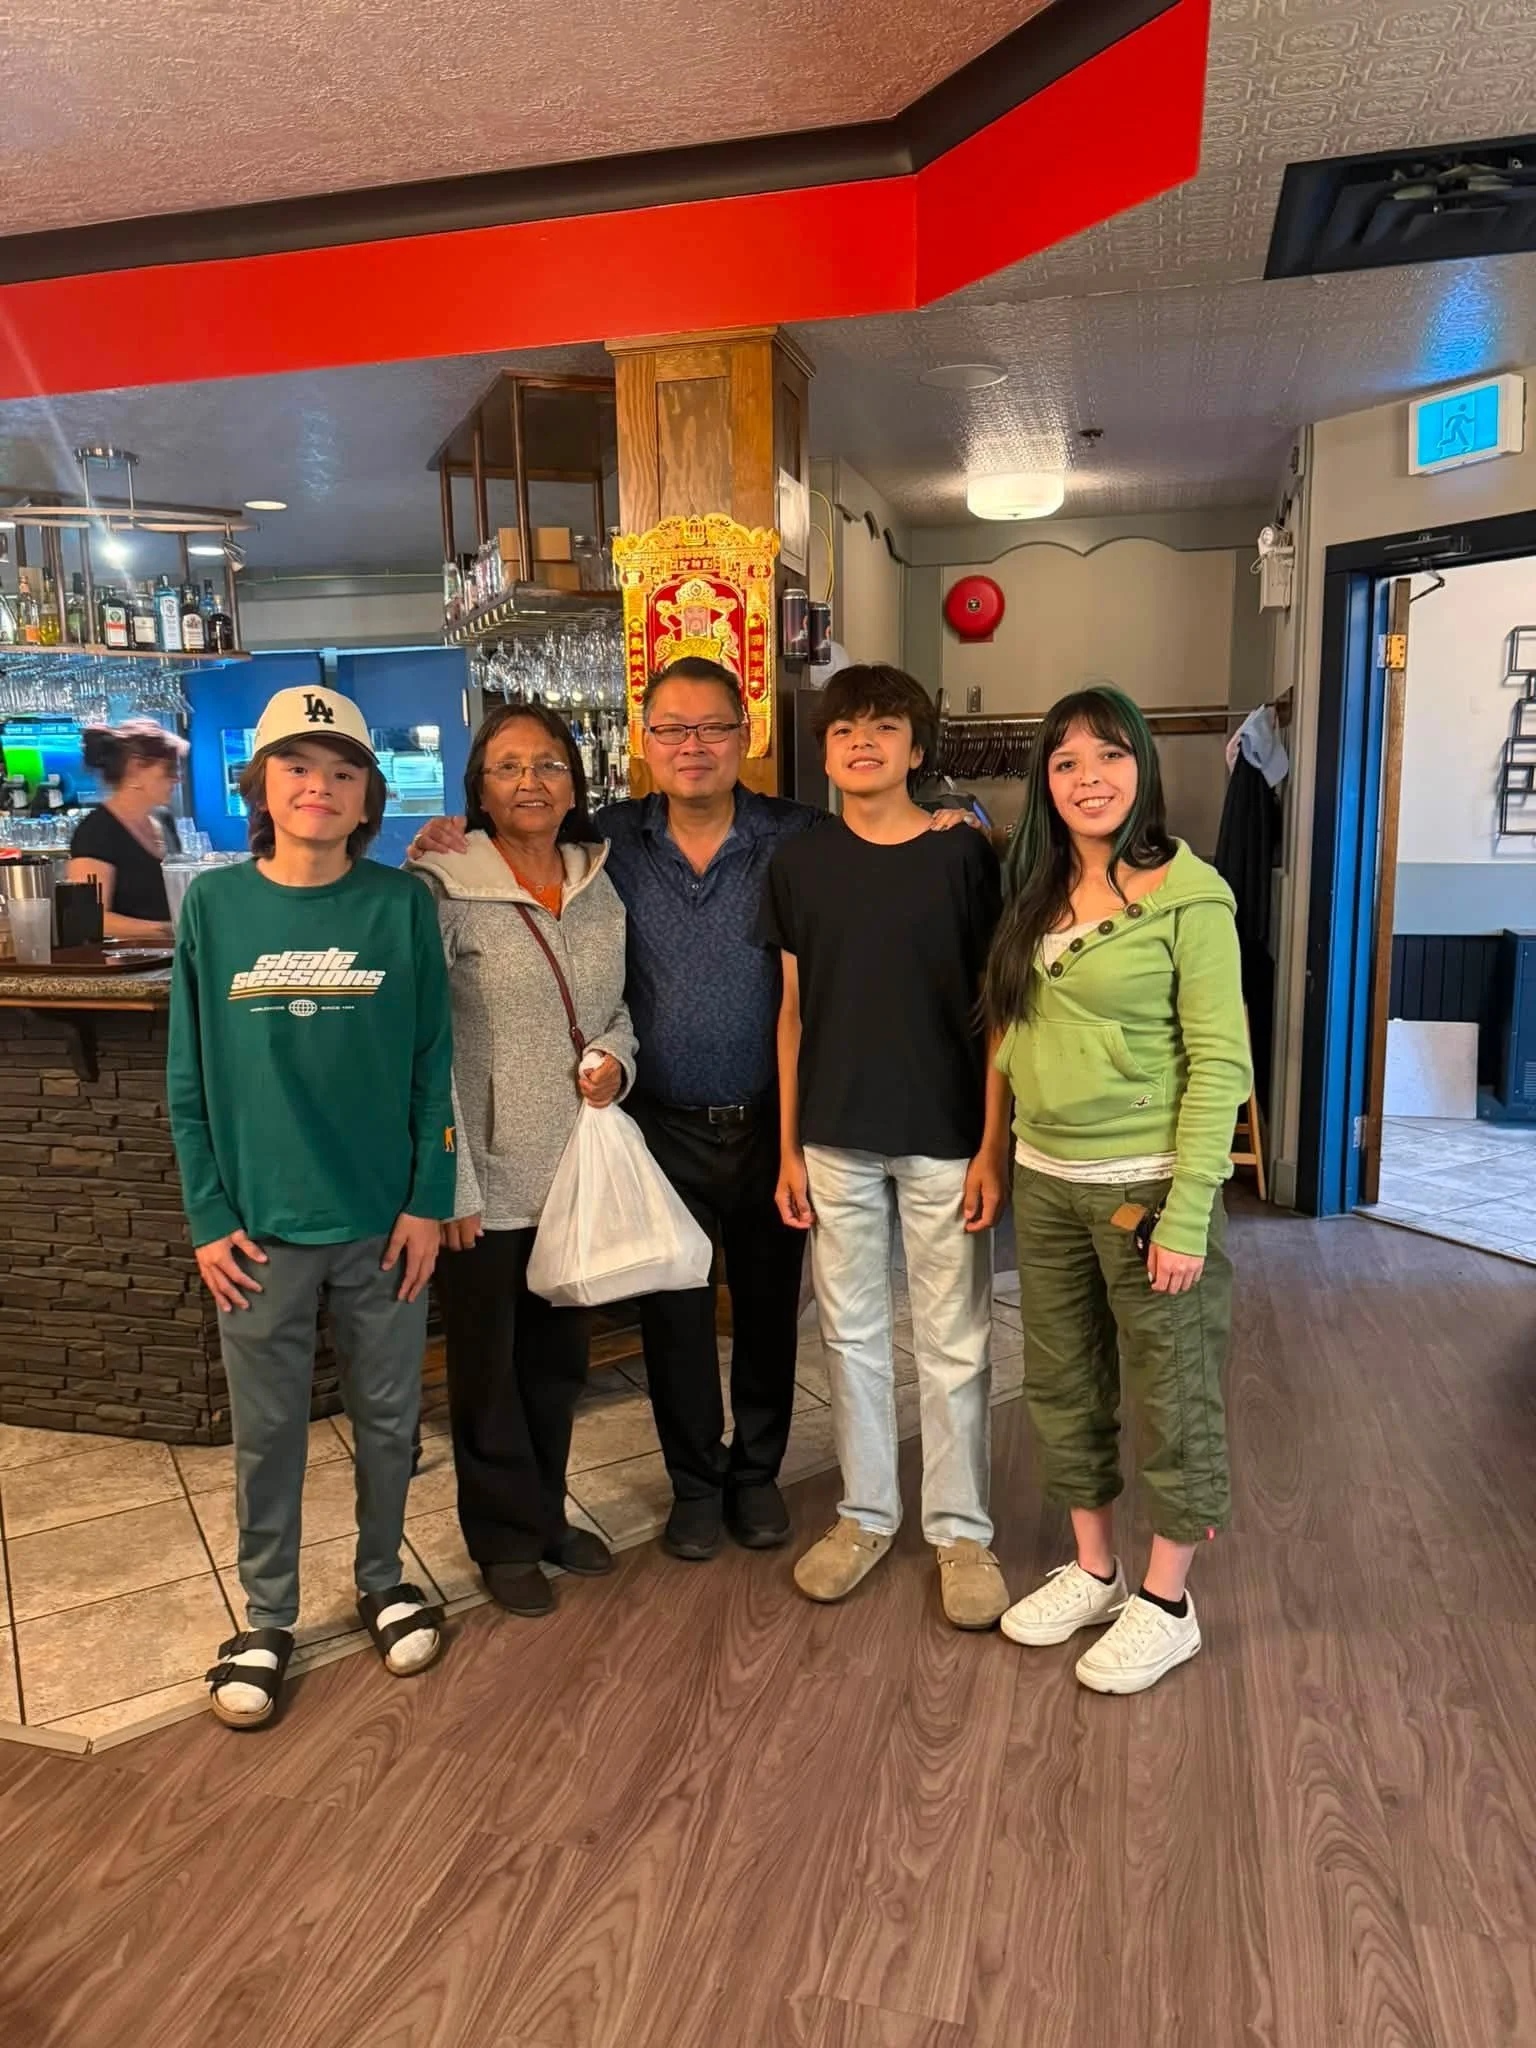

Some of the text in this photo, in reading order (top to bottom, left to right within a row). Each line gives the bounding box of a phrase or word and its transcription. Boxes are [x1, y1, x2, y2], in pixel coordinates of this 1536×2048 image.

[302, 693, 335, 724] LA
[253, 947, 359, 970] skate
[231, 969, 387, 990] sessions
